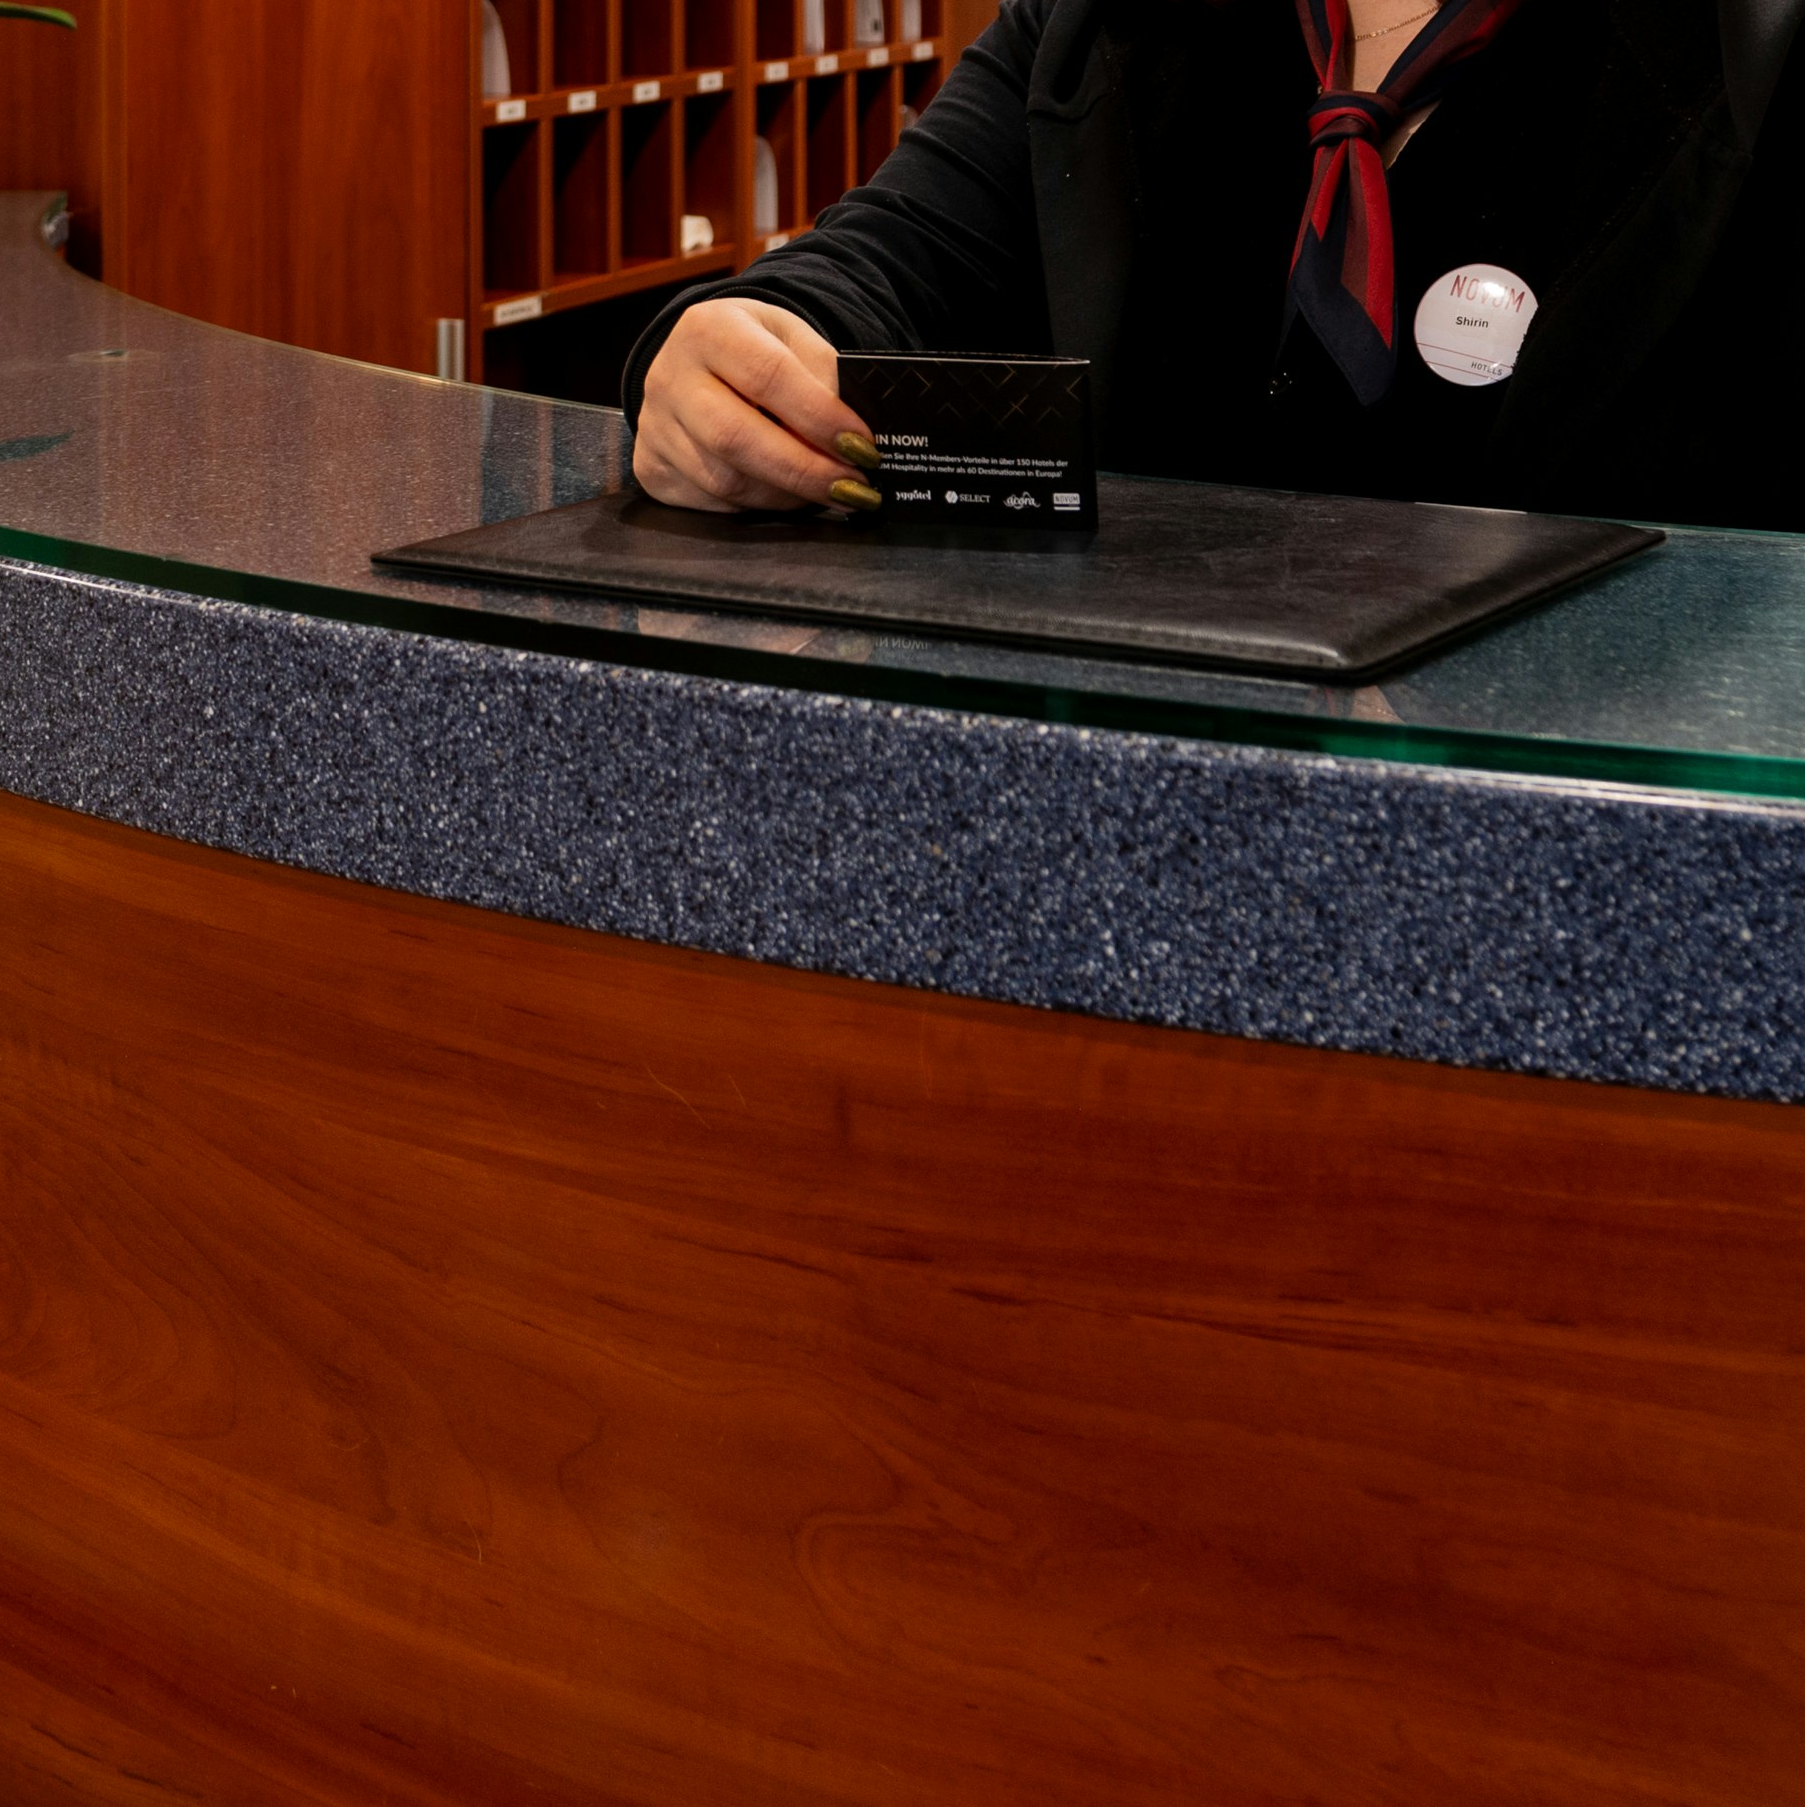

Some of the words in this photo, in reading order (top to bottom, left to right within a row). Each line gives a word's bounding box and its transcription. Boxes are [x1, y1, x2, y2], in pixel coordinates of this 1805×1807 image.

[1455, 315, 1489, 329] Shirin
[875, 434, 889, 446] IN
[891, 434, 929, 447] NOW!
[894, 452, 905, 461] Sie
[906, 452, 920, 461] Ihre
[921, 454, 990, 465] N-Members-Vorteile
[991, 457, 998, 465] in
[999, 457, 1015, 466] über
[1017, 458, 1031, 467] 150
[1032, 459, 1055, 467] Hotels
[891, 463, 928, 473] Hospitality
[929, 464, 937, 472] in
[937, 464, 955, 473] mehr
[956, 465, 966, 474] als
[967, 466, 977, 474] 60
[978, 468, 1026, 476] Destinationen
[1027, 469, 1034, 477] in
[1035, 469, 1063, 478] Europa!
[959, 494, 991, 503] SELECT
[1054, 494, 1079, 504] NOVUM
